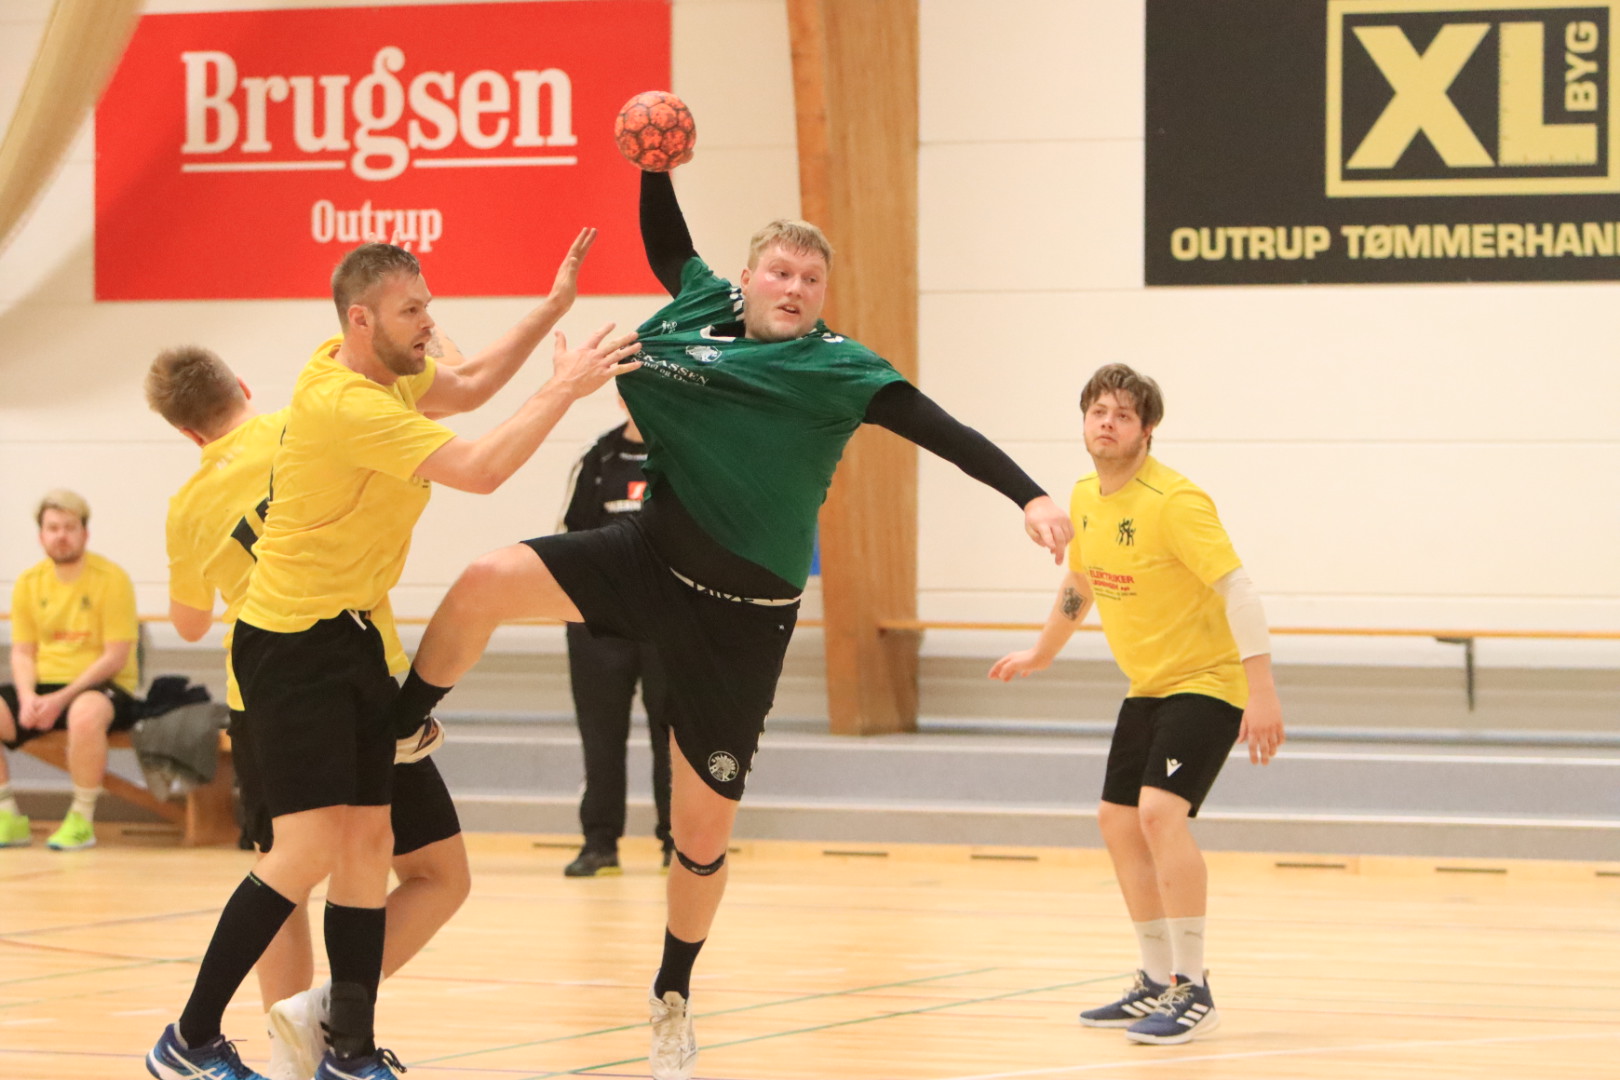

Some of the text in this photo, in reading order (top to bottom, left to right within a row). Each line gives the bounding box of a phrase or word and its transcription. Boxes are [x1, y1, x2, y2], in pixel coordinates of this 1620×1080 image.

[1345, 21, 1598, 169] XL
[1564, 20, 1600, 112] BYG
[181, 46, 578, 181] Brugsen
[311, 199, 443, 253] Outrup
[1170, 222, 1620, 260] OUTRUP TØMMERHAN
